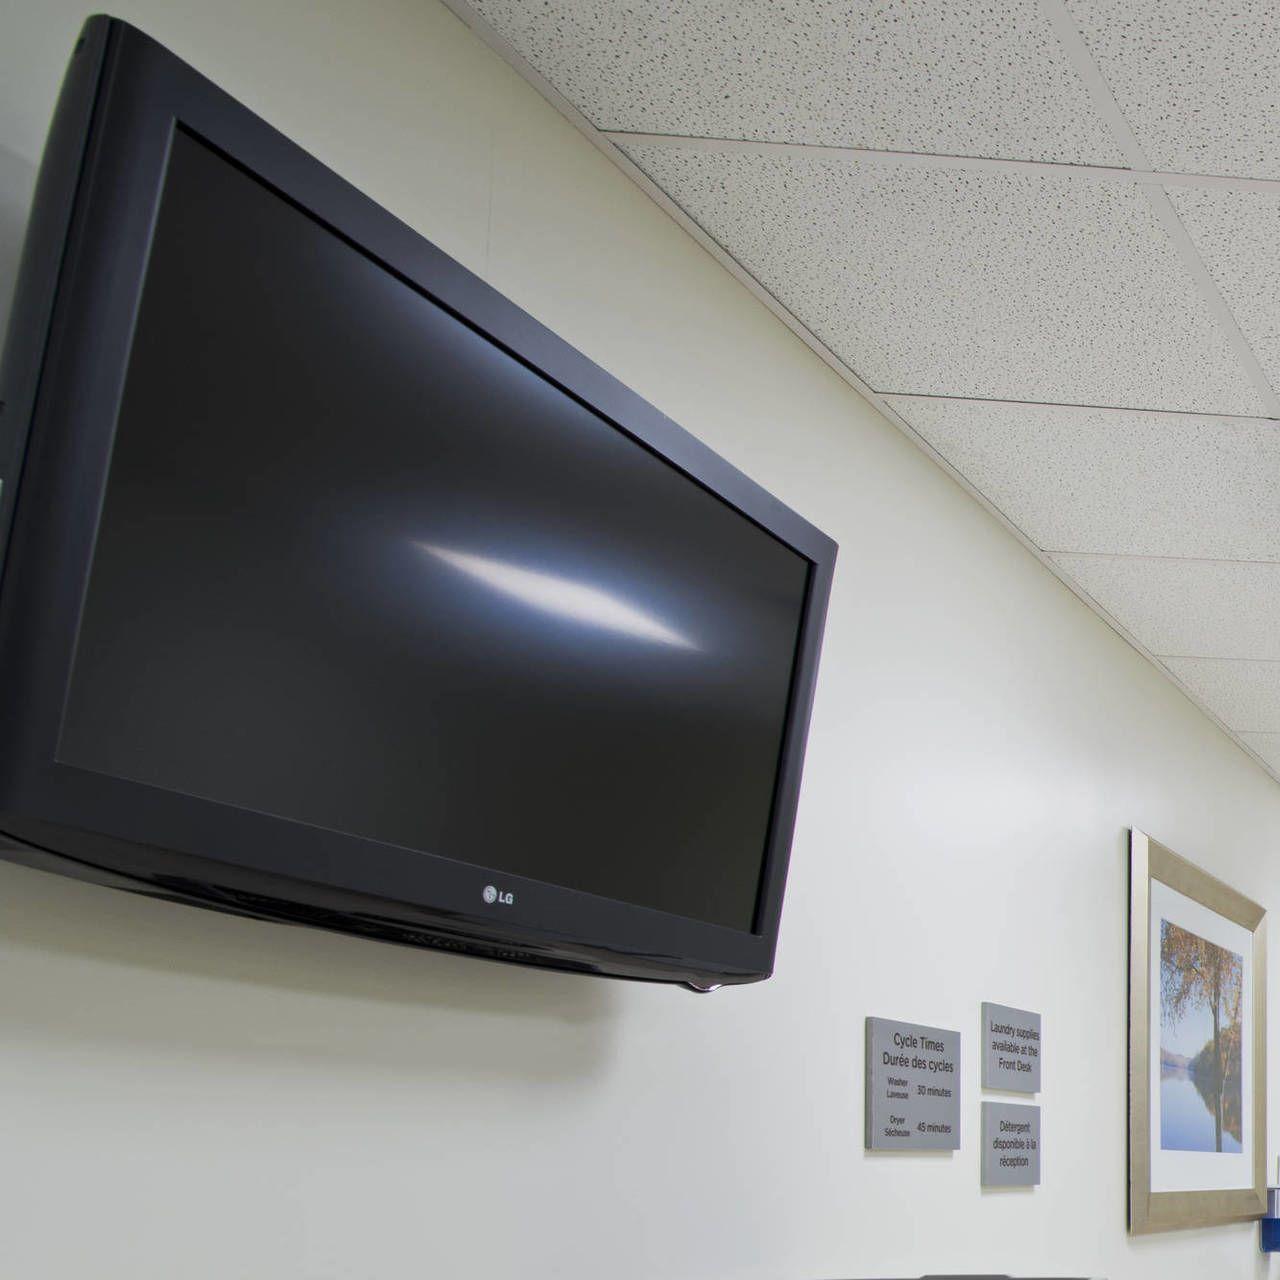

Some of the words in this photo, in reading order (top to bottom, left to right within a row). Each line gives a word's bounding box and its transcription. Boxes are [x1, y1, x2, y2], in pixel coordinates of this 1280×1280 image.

[498, 891, 514, 905] LG
[991, 1020, 1015, 1038] Laundry
[1016, 1027, 1040, 1040] supplies
[894, 1033, 918, 1049] Cycle
[919, 1036, 945, 1052] Times
[992, 1040, 1020, 1055] available
[1020, 1045, 1027, 1055] at
[1028, 1045, 1038, 1056] the
[883, 1051, 909, 1067] Durée
[912, 1056, 927, 1069] des
[928, 1059, 954, 1073] cycles
[999, 1058, 1016, 1070] Front
[1017, 1060, 1032, 1072] Desk
[888, 1077, 908, 1087] Washer
[927, 1087, 952, 1098] minutes
[890, 1115, 905, 1126] Dryer
[918, 1121, 926, 1132] 45
[927, 1123, 952, 1134] minutes
[1000, 1120, 1030, 1134] Détergent
[993, 1137, 1024, 1151] disponible
[1000, 1155, 1028, 1168] réception
